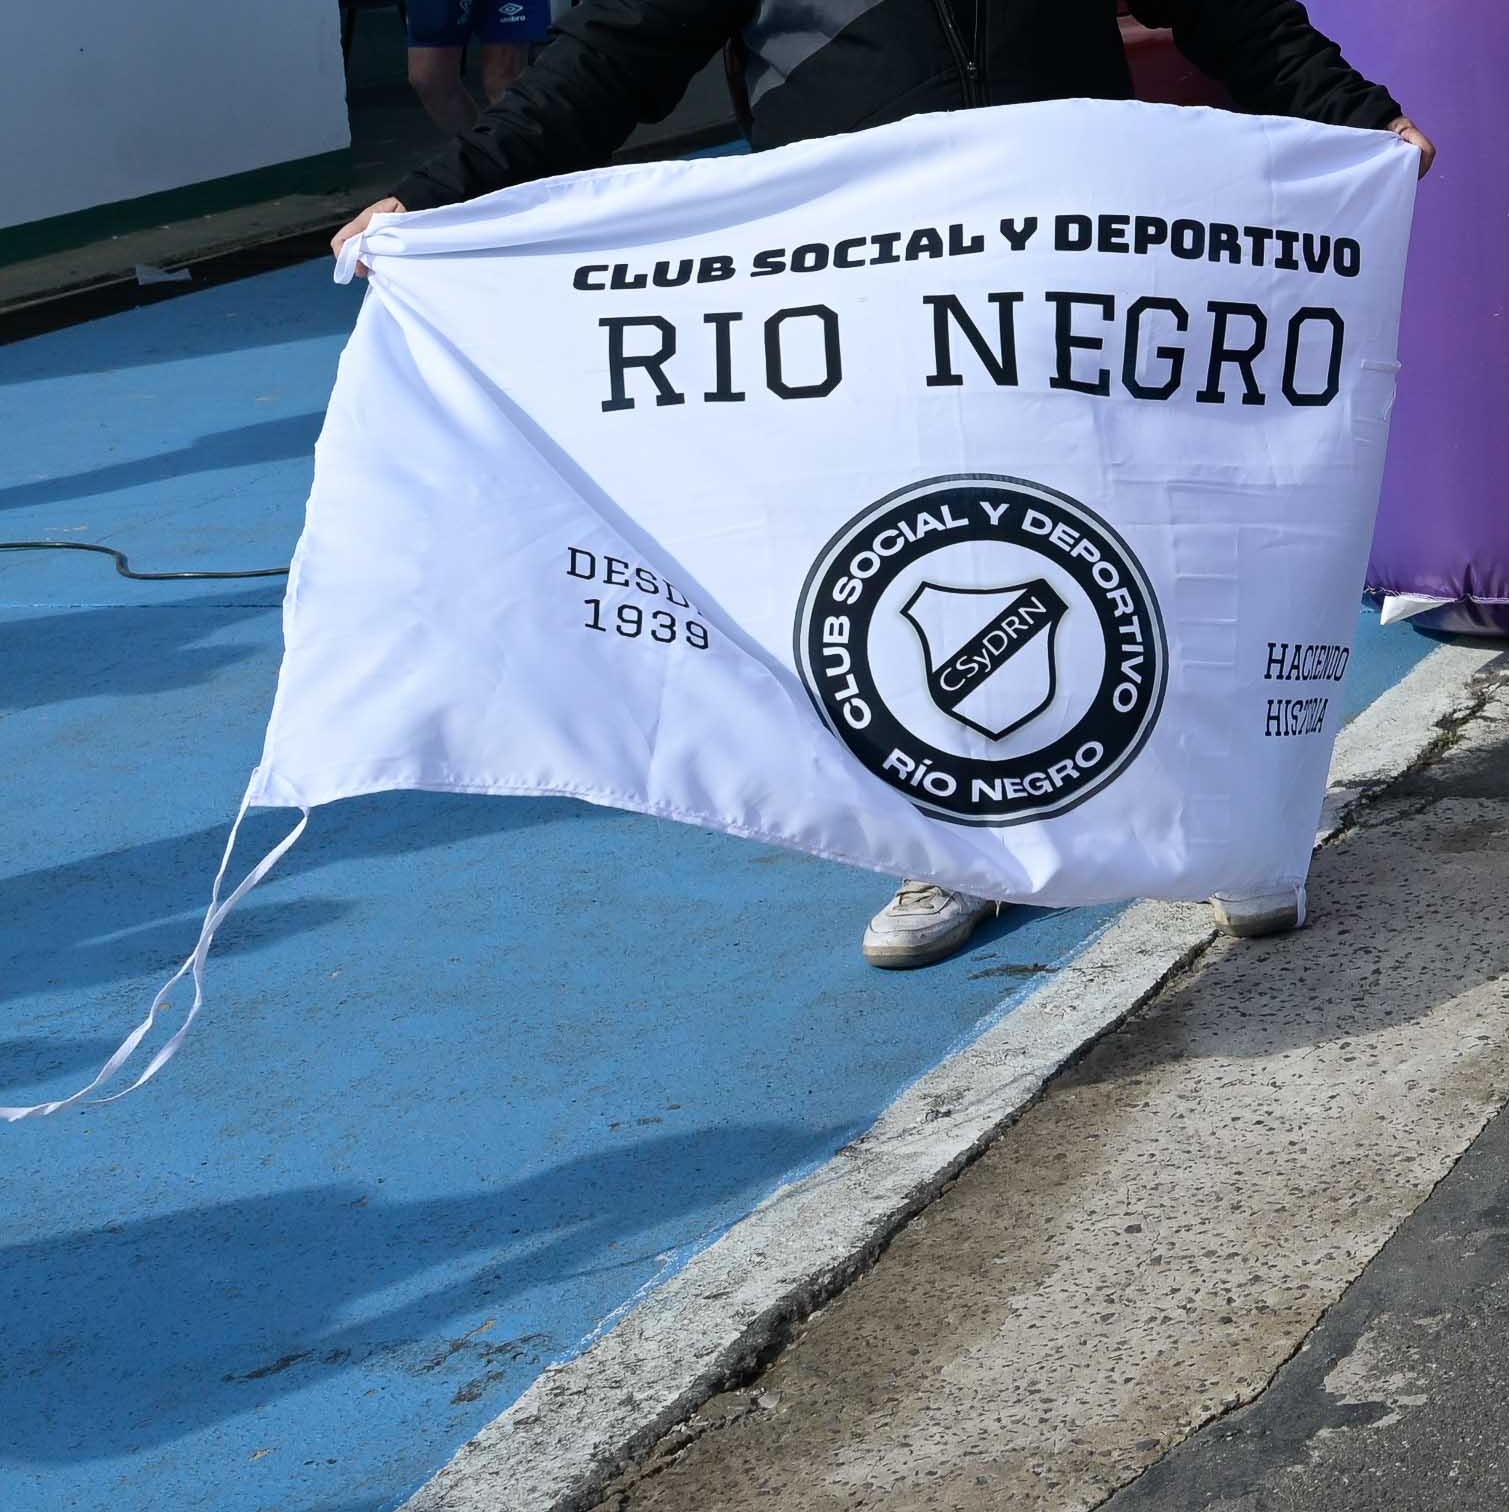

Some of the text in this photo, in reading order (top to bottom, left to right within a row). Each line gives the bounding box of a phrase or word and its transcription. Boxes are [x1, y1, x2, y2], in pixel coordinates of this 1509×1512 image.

[573, 214, 1361, 290] CLUB SOCIAL Y DEPORTIVO
[598, 291, 1345, 412] RIO NEGRO
[584, 598, 709, 650] 1939
[823, 501, 1145, 730] CLUB SOCIAL Y DEPORTIVO
[939, 595, 1047, 692] CSyDRN
[1264, 642, 1350, 681] HACIENDO
[882, 740, 1105, 802] RÍO NEGRO
